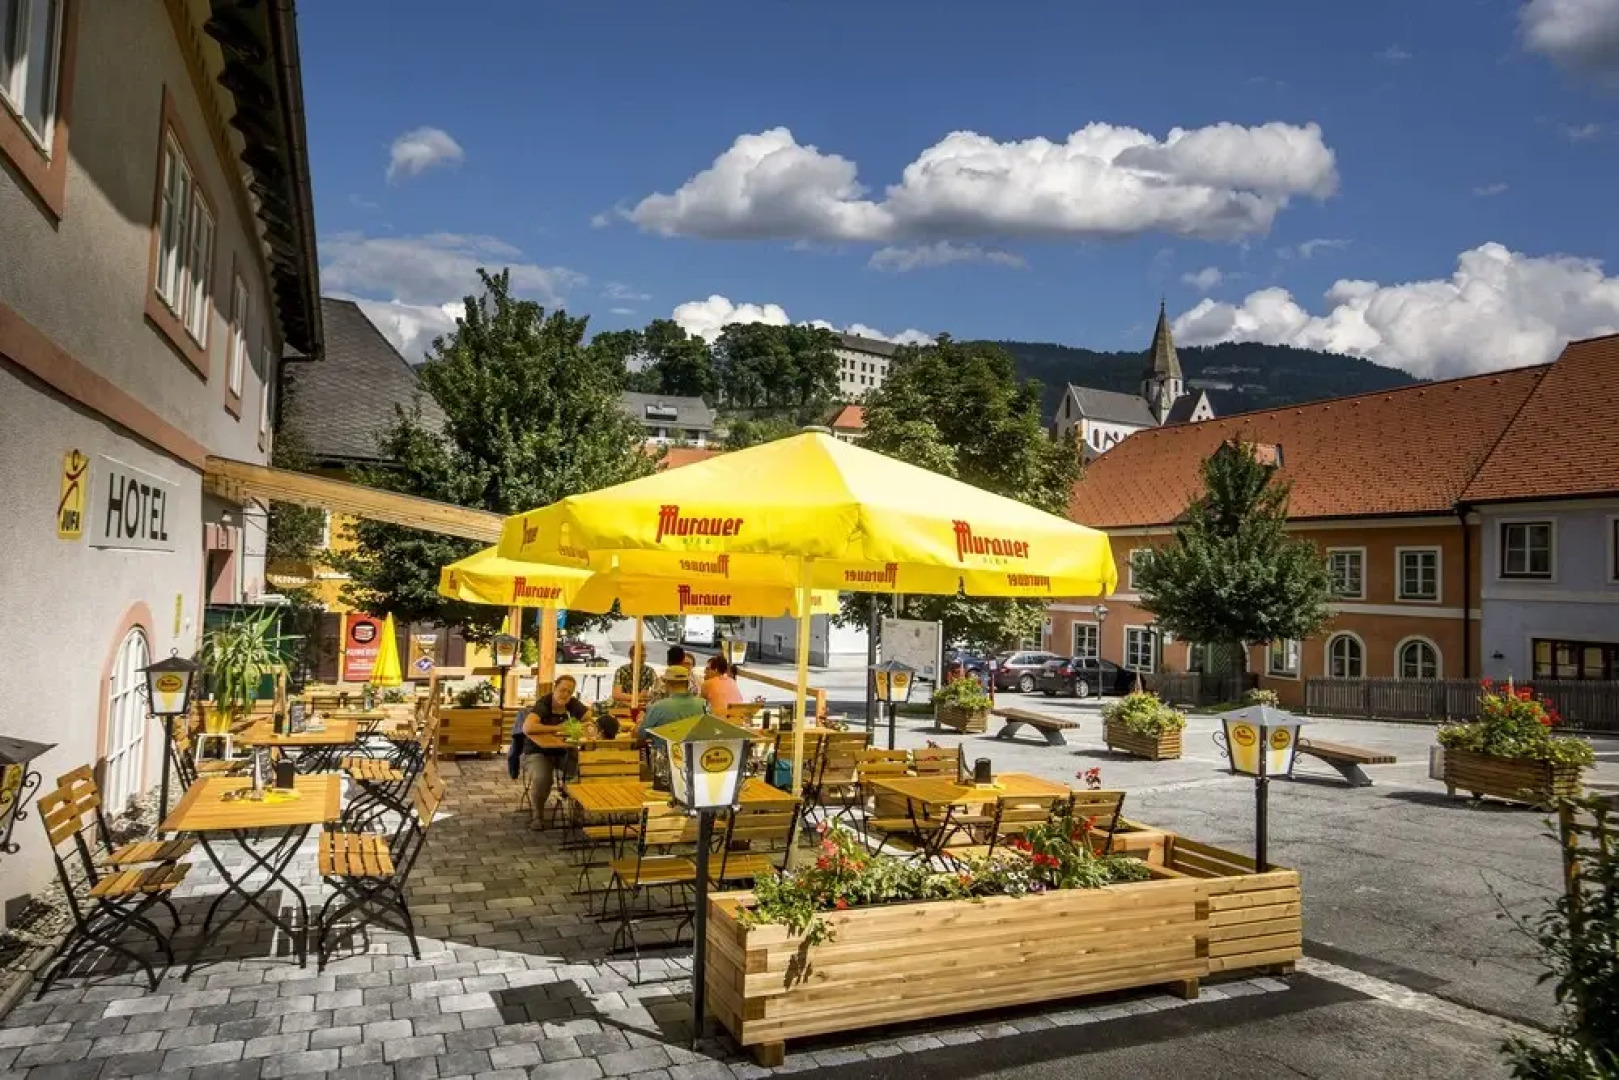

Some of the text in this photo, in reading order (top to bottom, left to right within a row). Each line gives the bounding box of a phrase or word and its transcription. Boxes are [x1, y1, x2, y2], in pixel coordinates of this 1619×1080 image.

[105, 472, 168, 541] HOTEL
[656, 505, 744, 544] Murauer
[952, 519, 1029, 562] Murauer
[513, 576, 562, 603] Murauer
[678, 584, 732, 612] Murauer
